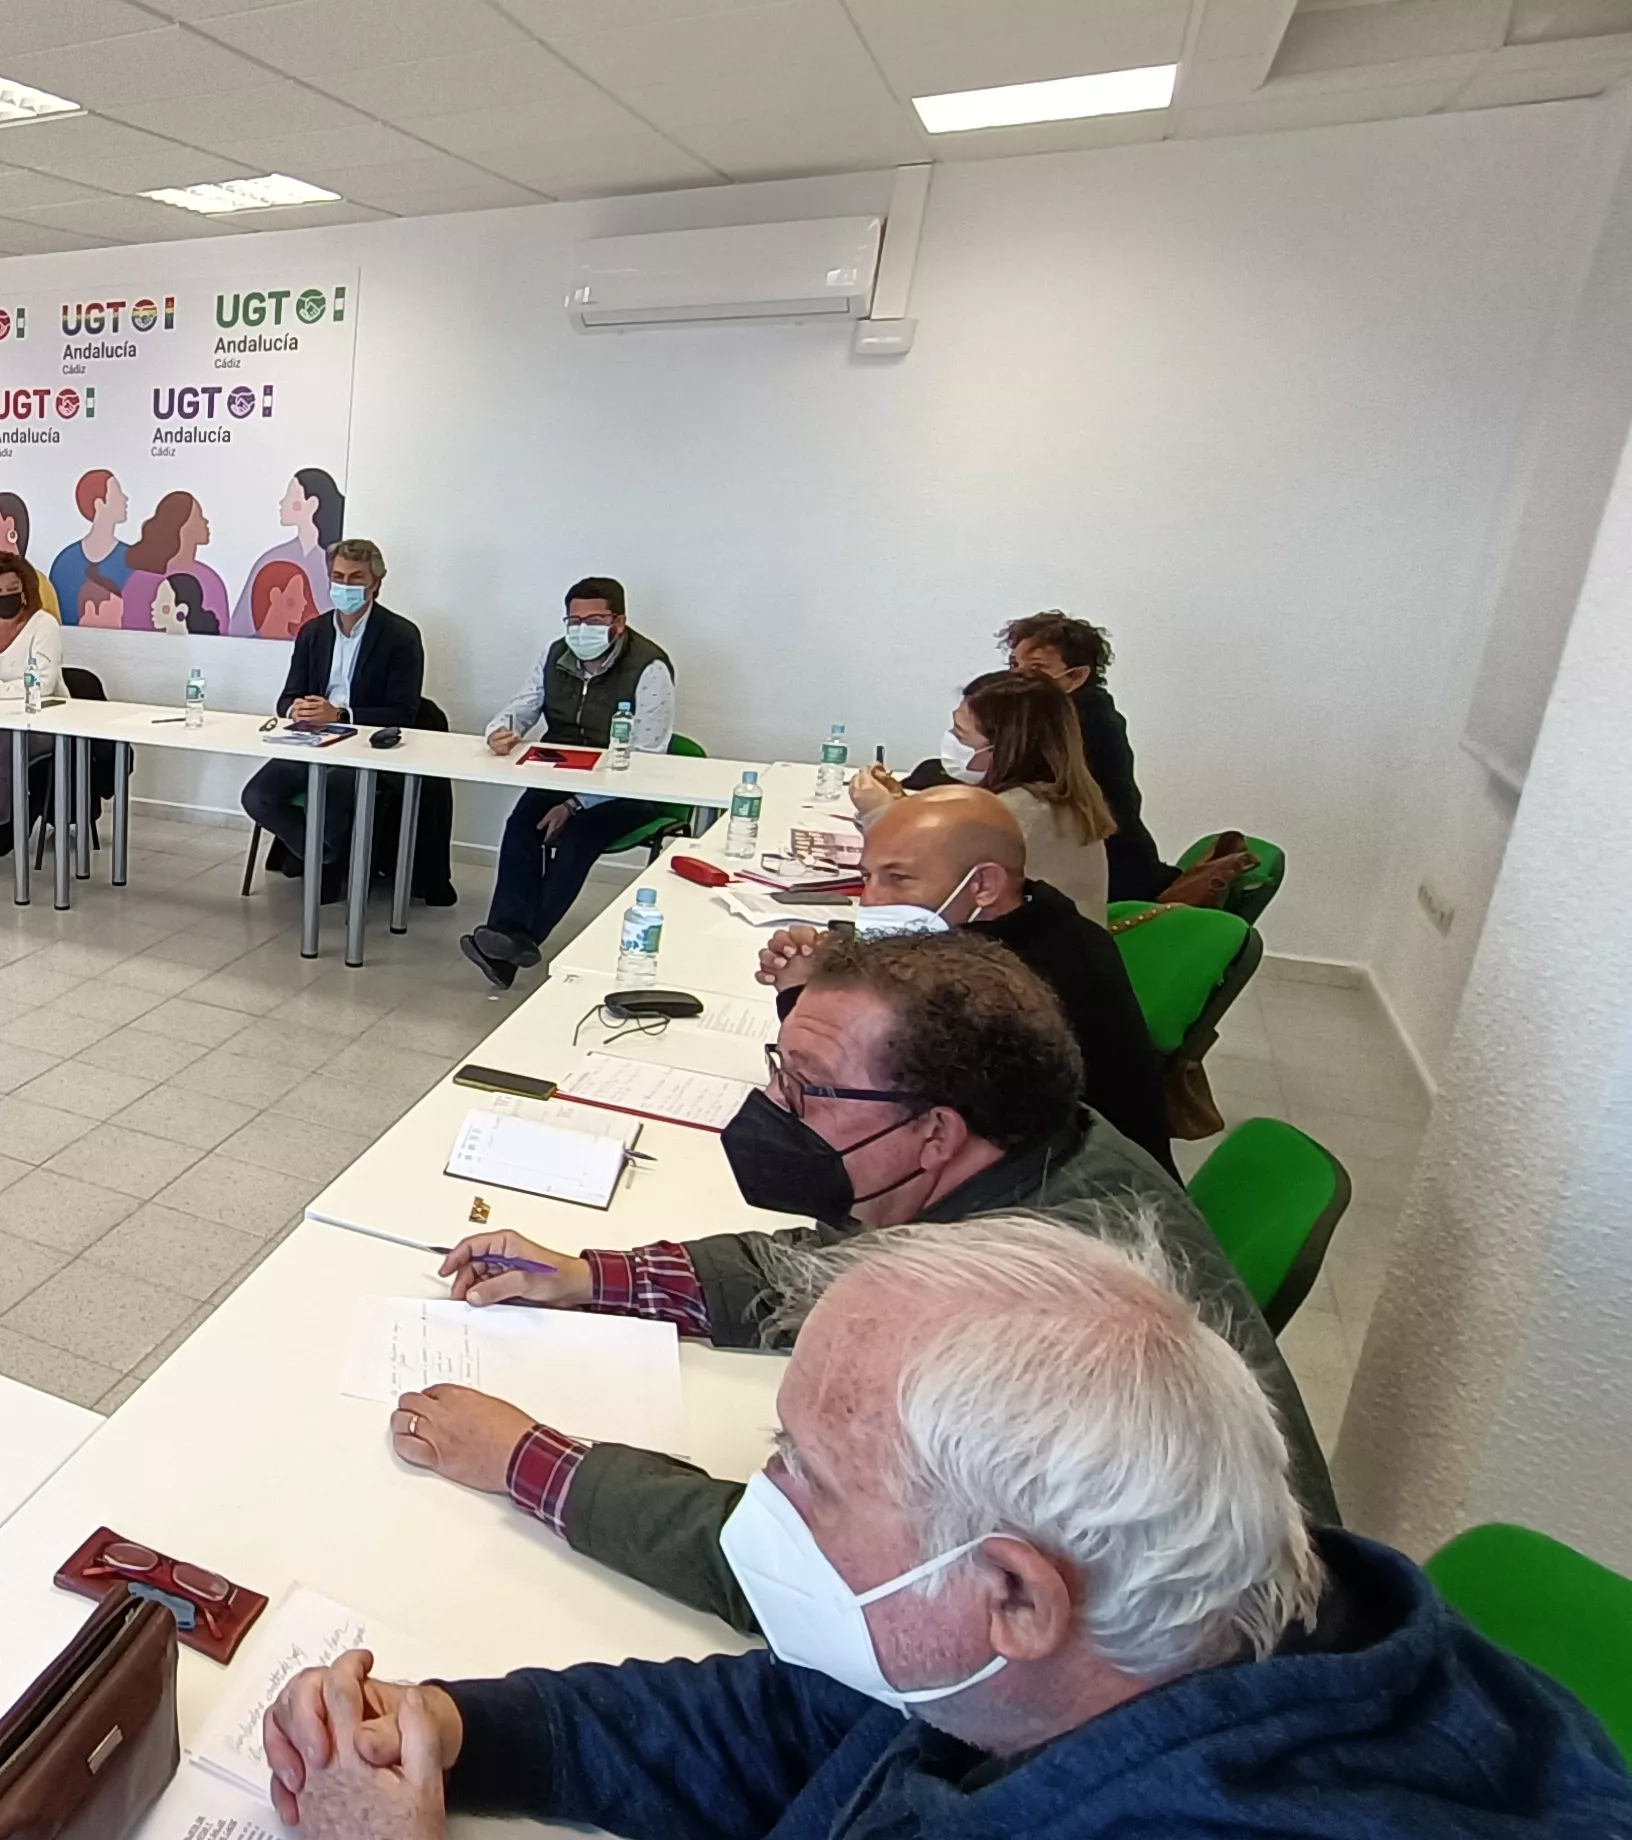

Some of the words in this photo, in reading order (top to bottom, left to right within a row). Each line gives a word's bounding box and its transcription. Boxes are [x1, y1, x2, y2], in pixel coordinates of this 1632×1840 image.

[62, 301, 126, 336] UGT
[216, 290, 290, 328] UGT
[63, 341, 136, 360] Andalucía
[214, 333, 298, 354] Andalucía
[62, 364, 86, 374] Cádiz
[214, 359, 241, 369] Cádiz
[153, 386, 222, 420] UGT
[153, 426, 231, 443] Andalucía
[151, 447, 176, 457] Cádiz
